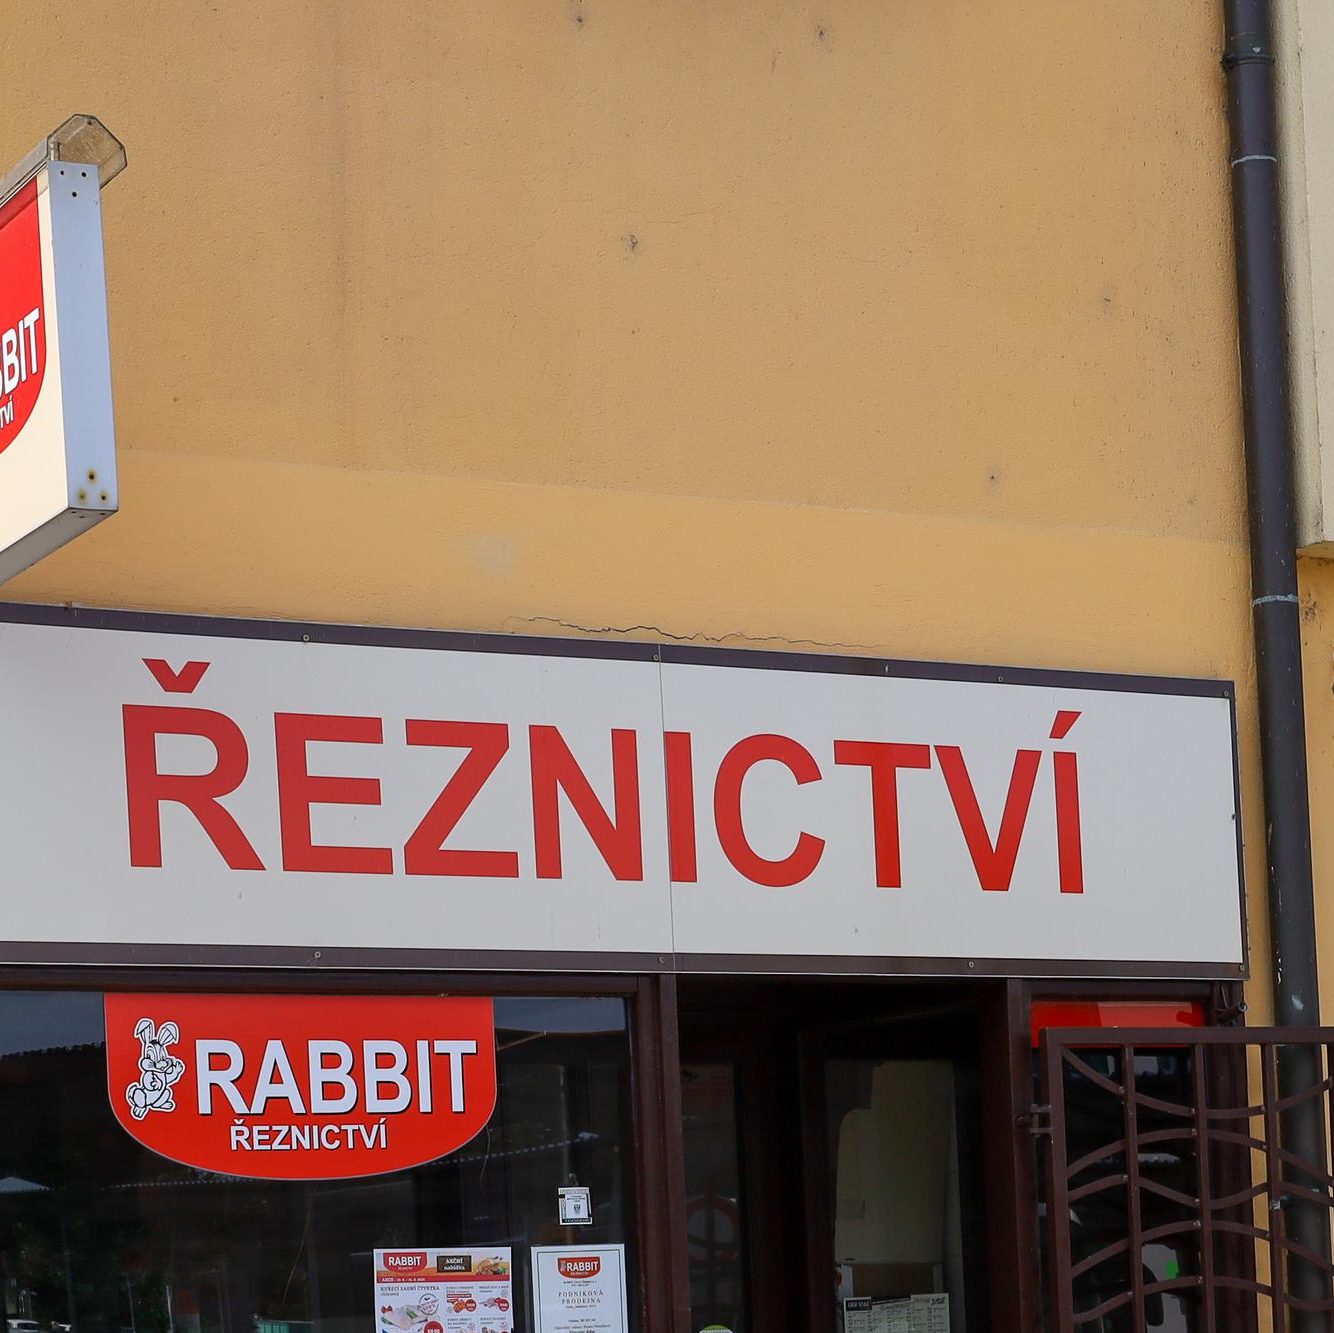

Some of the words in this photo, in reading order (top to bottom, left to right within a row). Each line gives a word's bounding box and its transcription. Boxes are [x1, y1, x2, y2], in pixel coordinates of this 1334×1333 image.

[121, 658, 1084, 894] ŘEZNICTVÍ
[194, 1037, 479, 1117] RABBIT
[229, 1116, 388, 1152] ŘEZNICTVÍ
[388, 1256, 422, 1267] RABBIT
[567, 1261, 599, 1272] RABBIT
